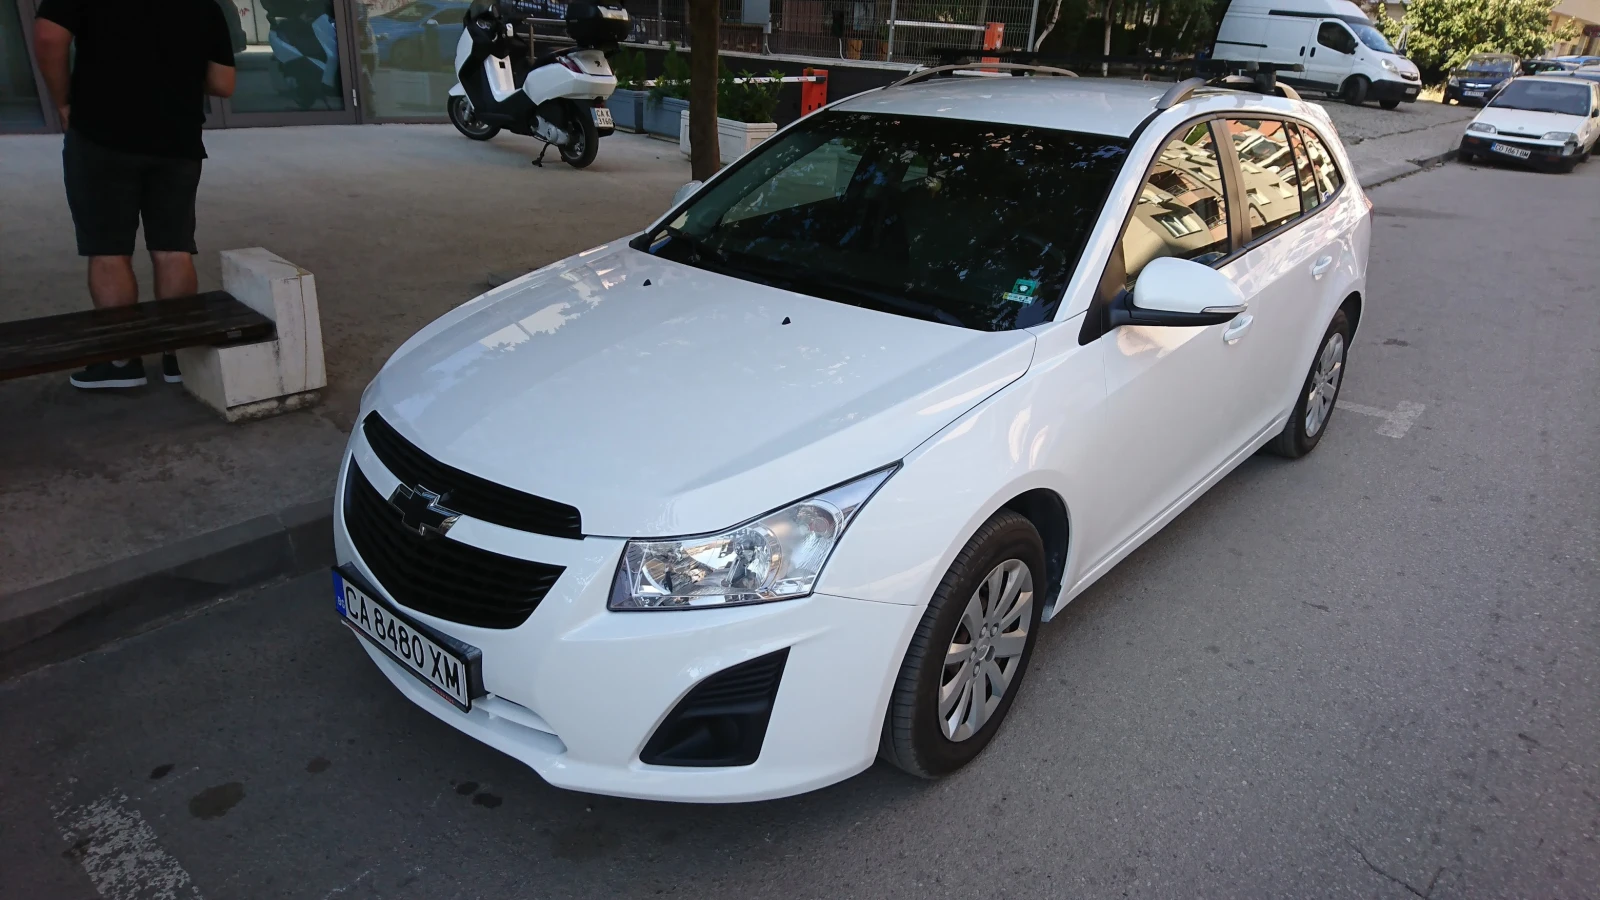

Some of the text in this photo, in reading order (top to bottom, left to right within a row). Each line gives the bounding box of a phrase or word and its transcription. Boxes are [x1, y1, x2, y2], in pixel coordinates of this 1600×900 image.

[346, 586, 371, 630] CA
[374, 607, 425, 669] 8480
[428, 644, 461, 697] XM
